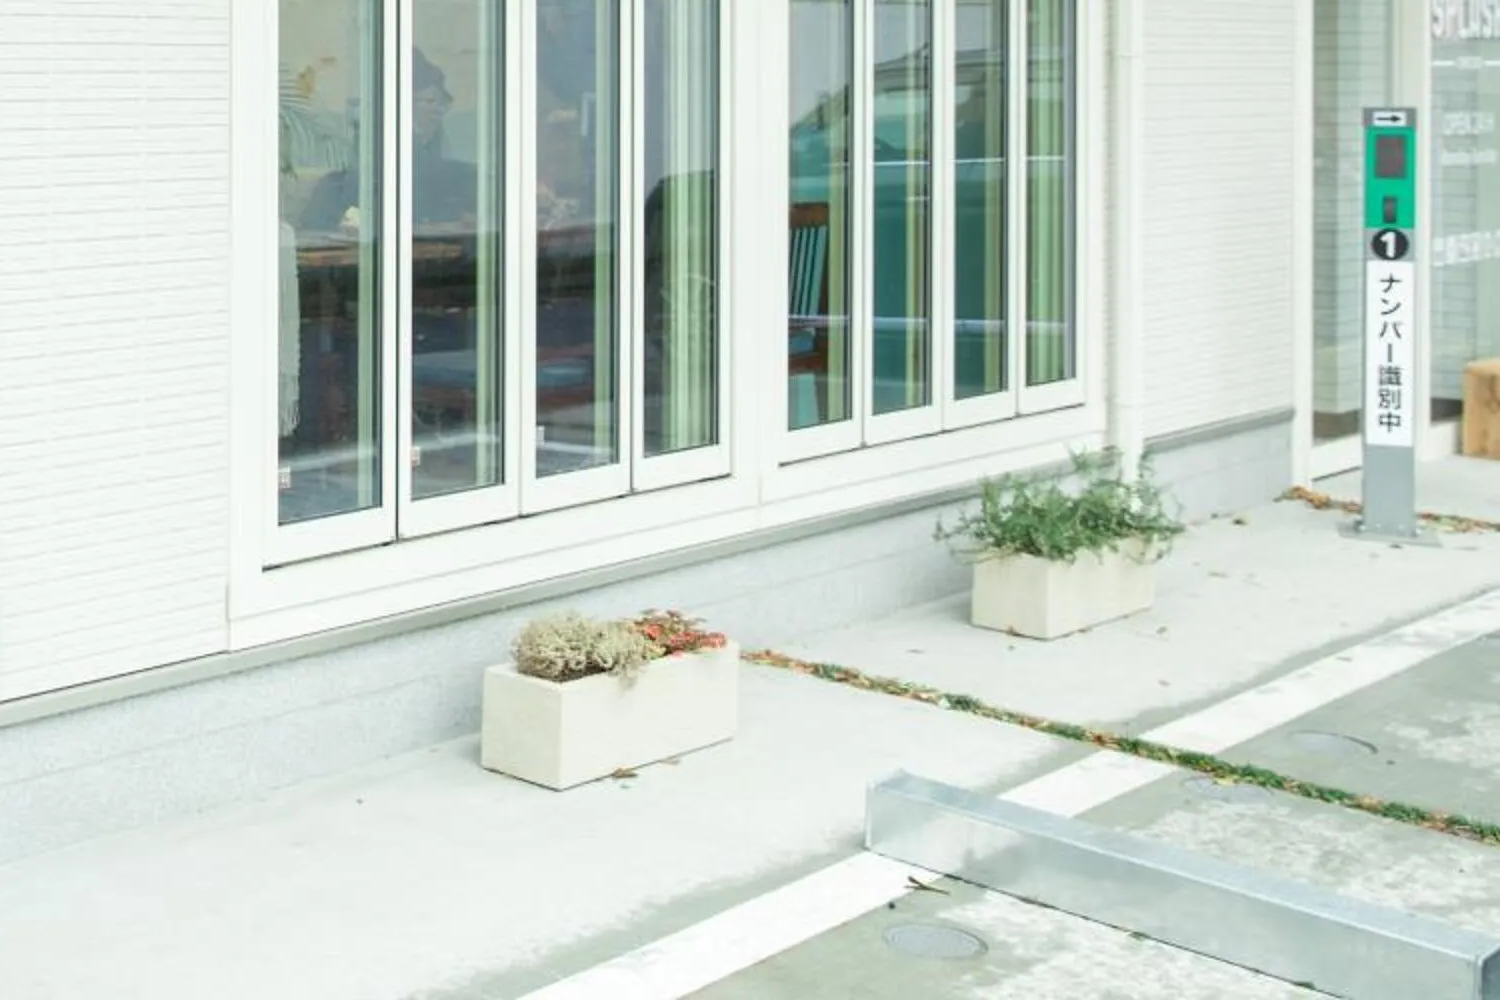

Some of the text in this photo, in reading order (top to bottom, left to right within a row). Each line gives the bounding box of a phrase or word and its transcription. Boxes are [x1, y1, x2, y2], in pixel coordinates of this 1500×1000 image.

[1378, 273, 1402, 433] ナンバー識別中
